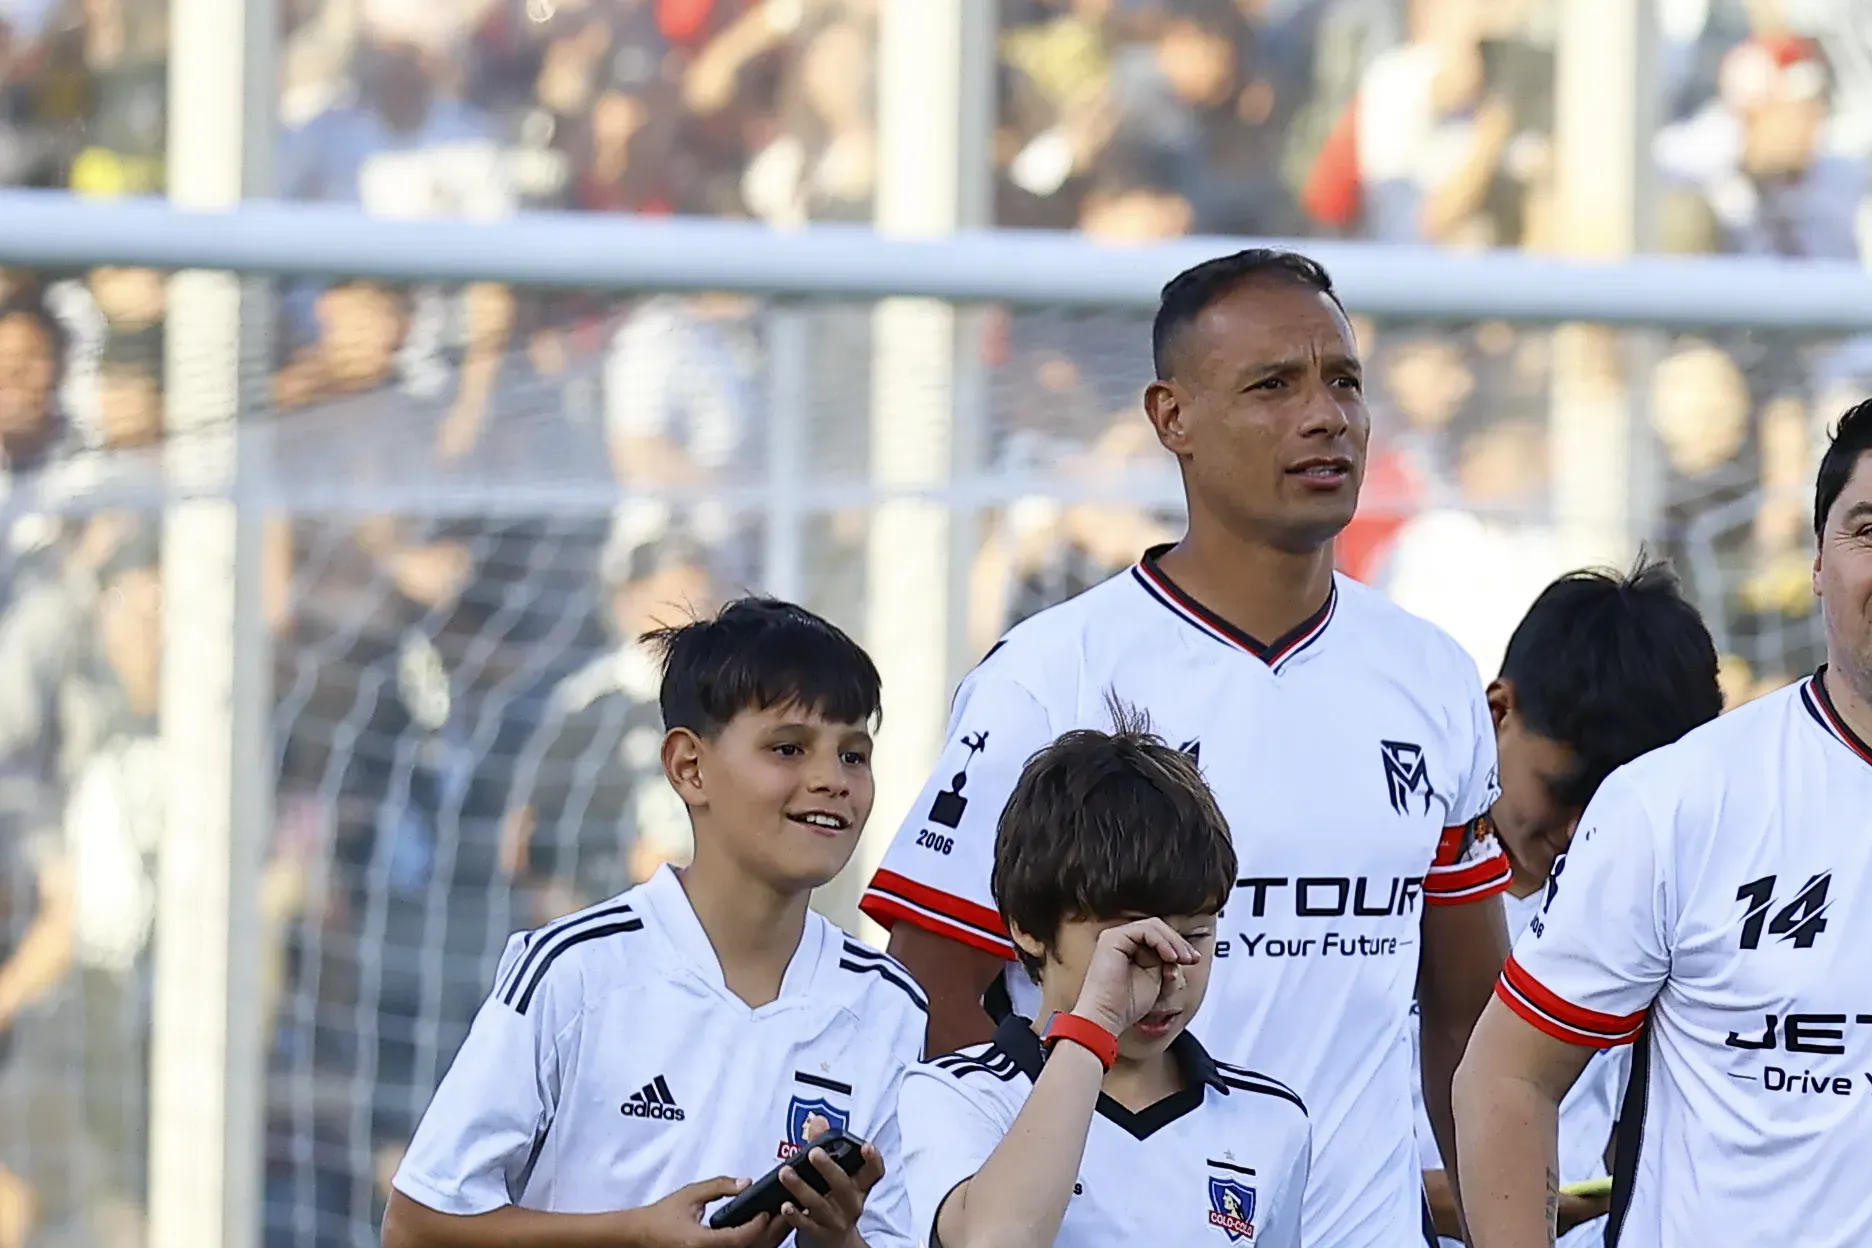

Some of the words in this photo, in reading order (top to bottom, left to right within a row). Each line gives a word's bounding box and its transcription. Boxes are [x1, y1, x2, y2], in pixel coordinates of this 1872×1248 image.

[916, 828, 954, 855] 2006
[1218, 876, 1425, 918] TOUR
[1735, 867, 1837, 950] 14
[1239, 932, 1316, 957] Your
[1322, 932, 1397, 957] Future
[1763, 1066, 1852, 1096] Drive
[620, 1101, 685, 1121] adidas
[1211, 1212, 1253, 1237] COLO-COLO
